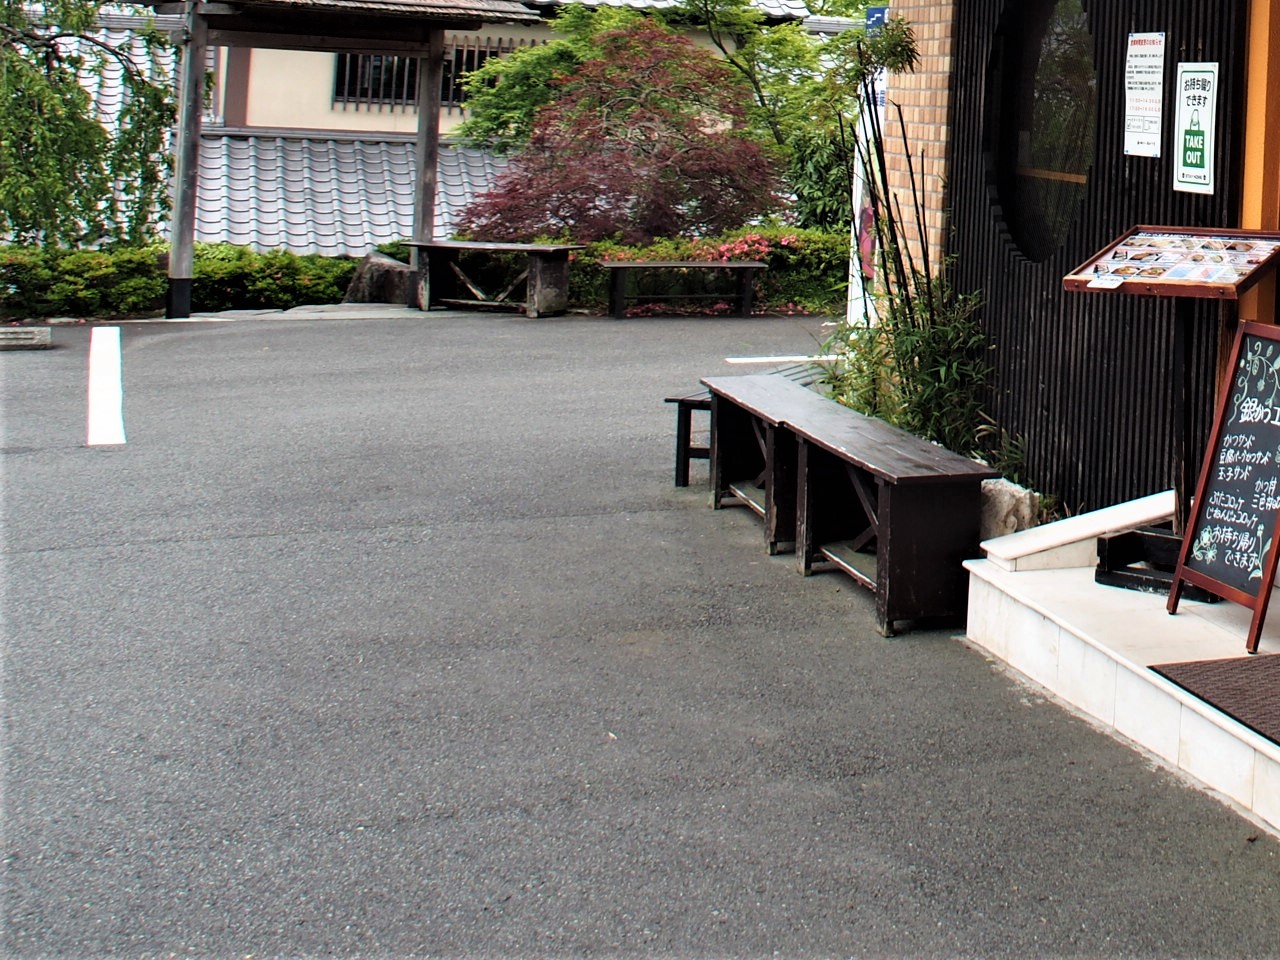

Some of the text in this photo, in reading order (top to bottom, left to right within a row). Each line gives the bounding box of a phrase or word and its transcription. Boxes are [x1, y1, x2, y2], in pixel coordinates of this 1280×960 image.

[1184, 77, 1211, 92] お持ち帰り
[1186, 94, 1208, 107] できます
[1185, 135, 1203, 149] TAKE
[1186, 151, 1201, 164] OUT
[1223, 433, 1255, 449] かつサンド
[1217, 465, 1252, 482] 玉子サンド
[1209, 490, 1245, 511] ぶたコロッケ
[1211, 524, 1257, 553] お持ち帰り
